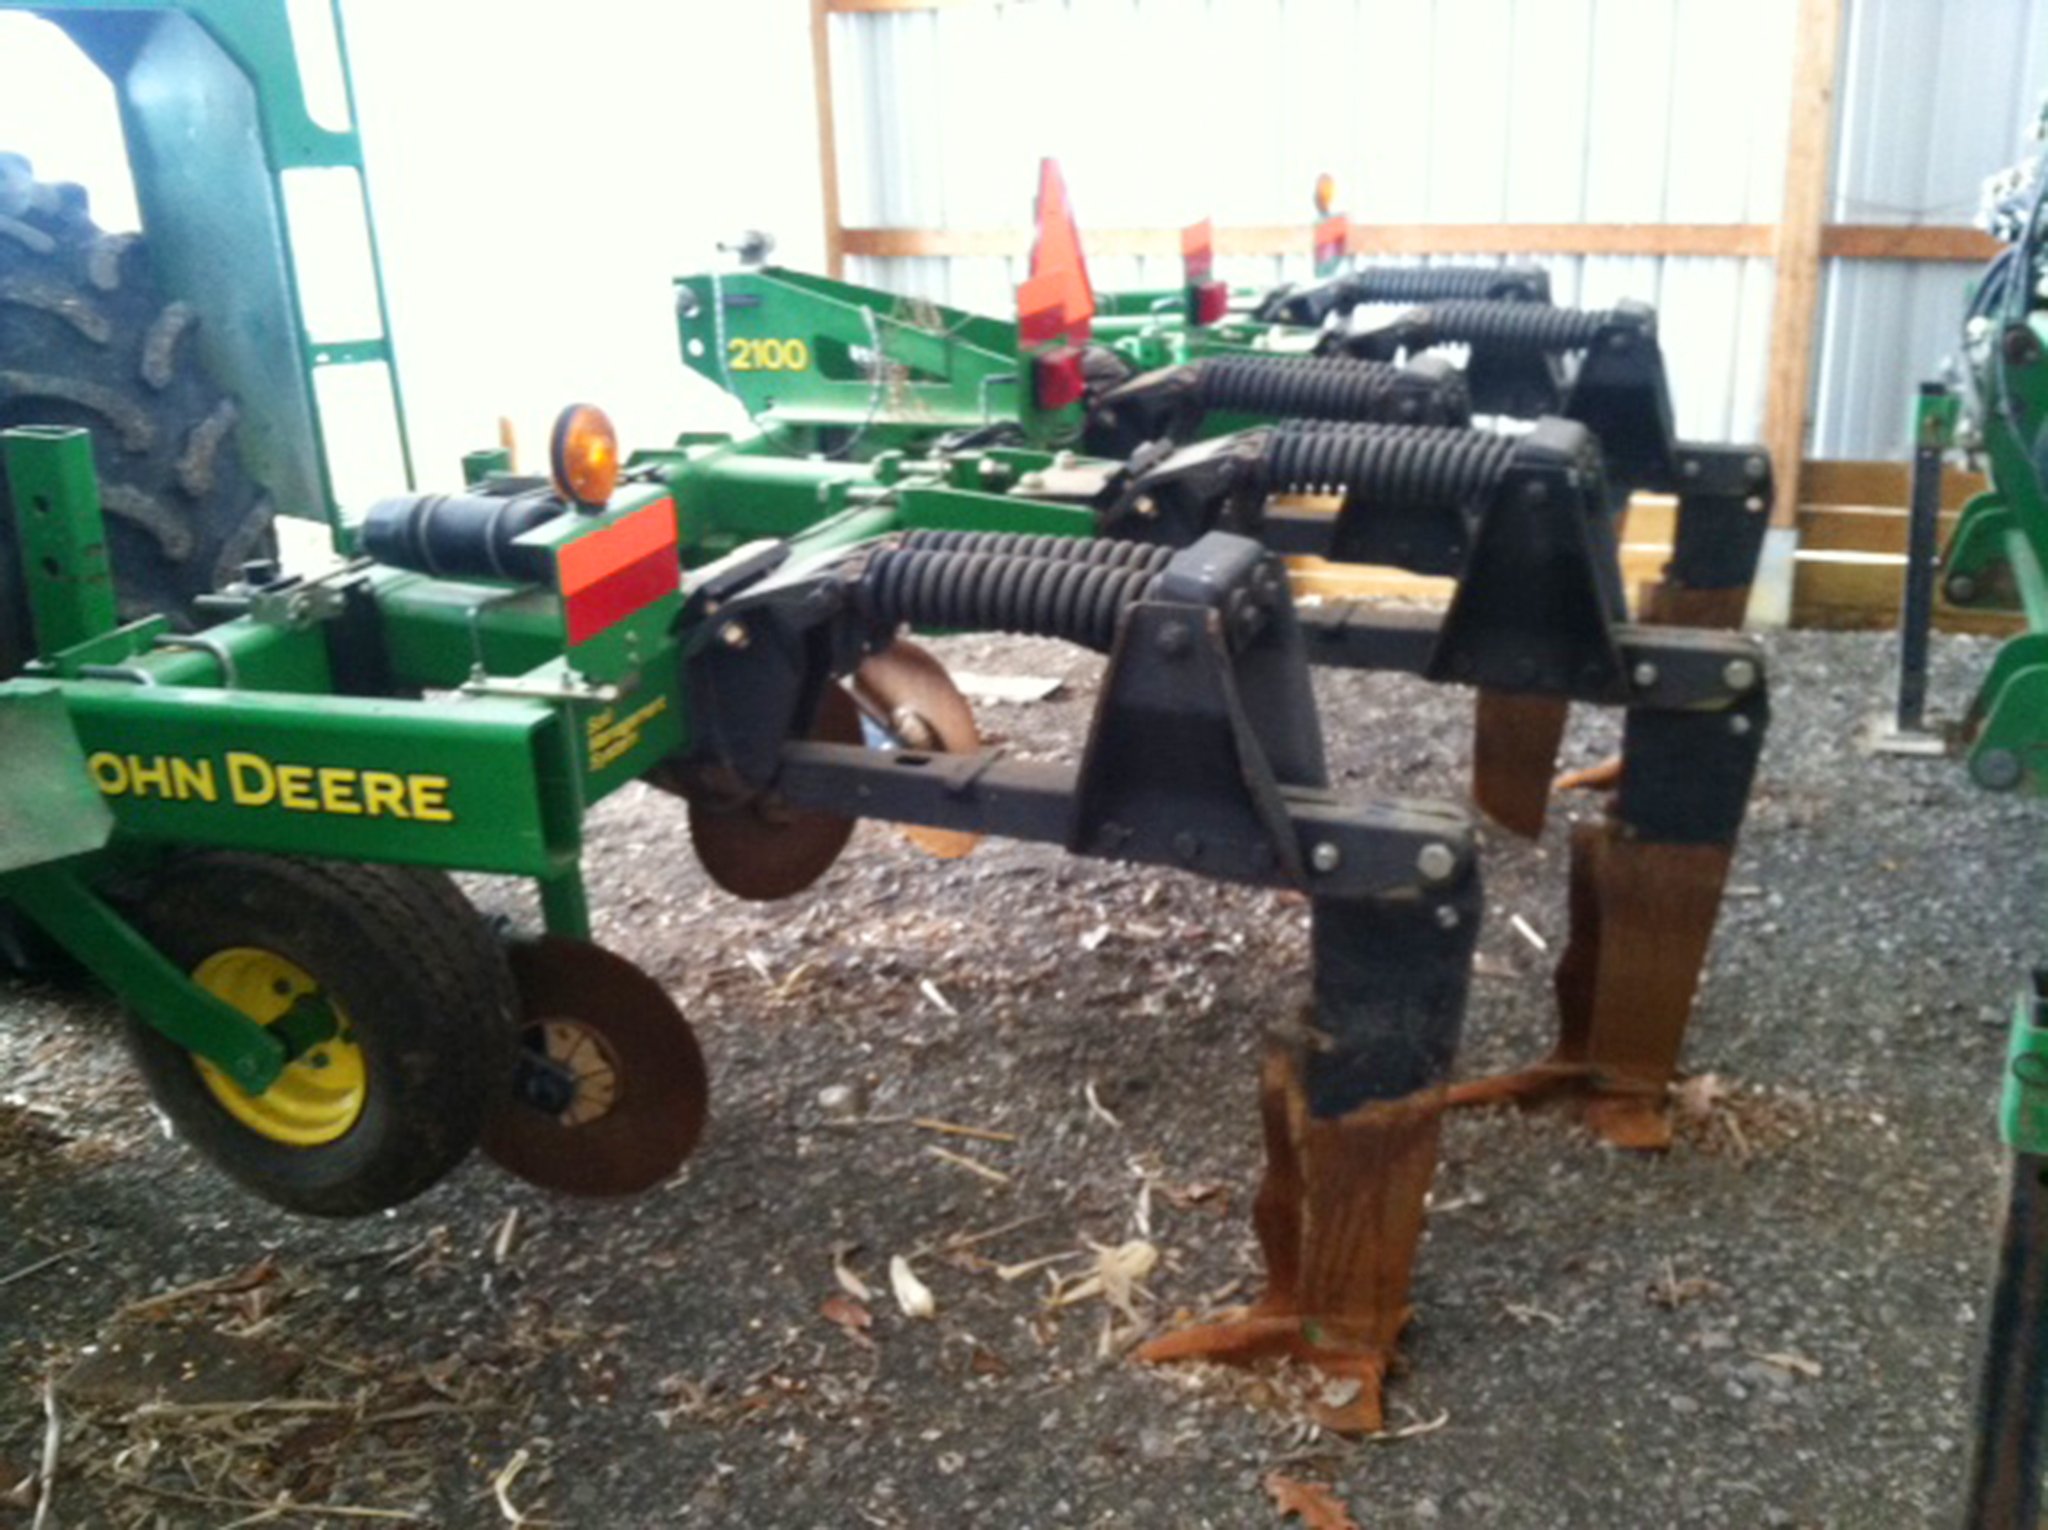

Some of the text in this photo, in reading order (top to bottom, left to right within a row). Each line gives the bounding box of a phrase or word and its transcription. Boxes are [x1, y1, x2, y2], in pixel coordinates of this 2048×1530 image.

[729, 338, 808, 371] 2100
[87, 751, 454, 823] OHN DEERE
